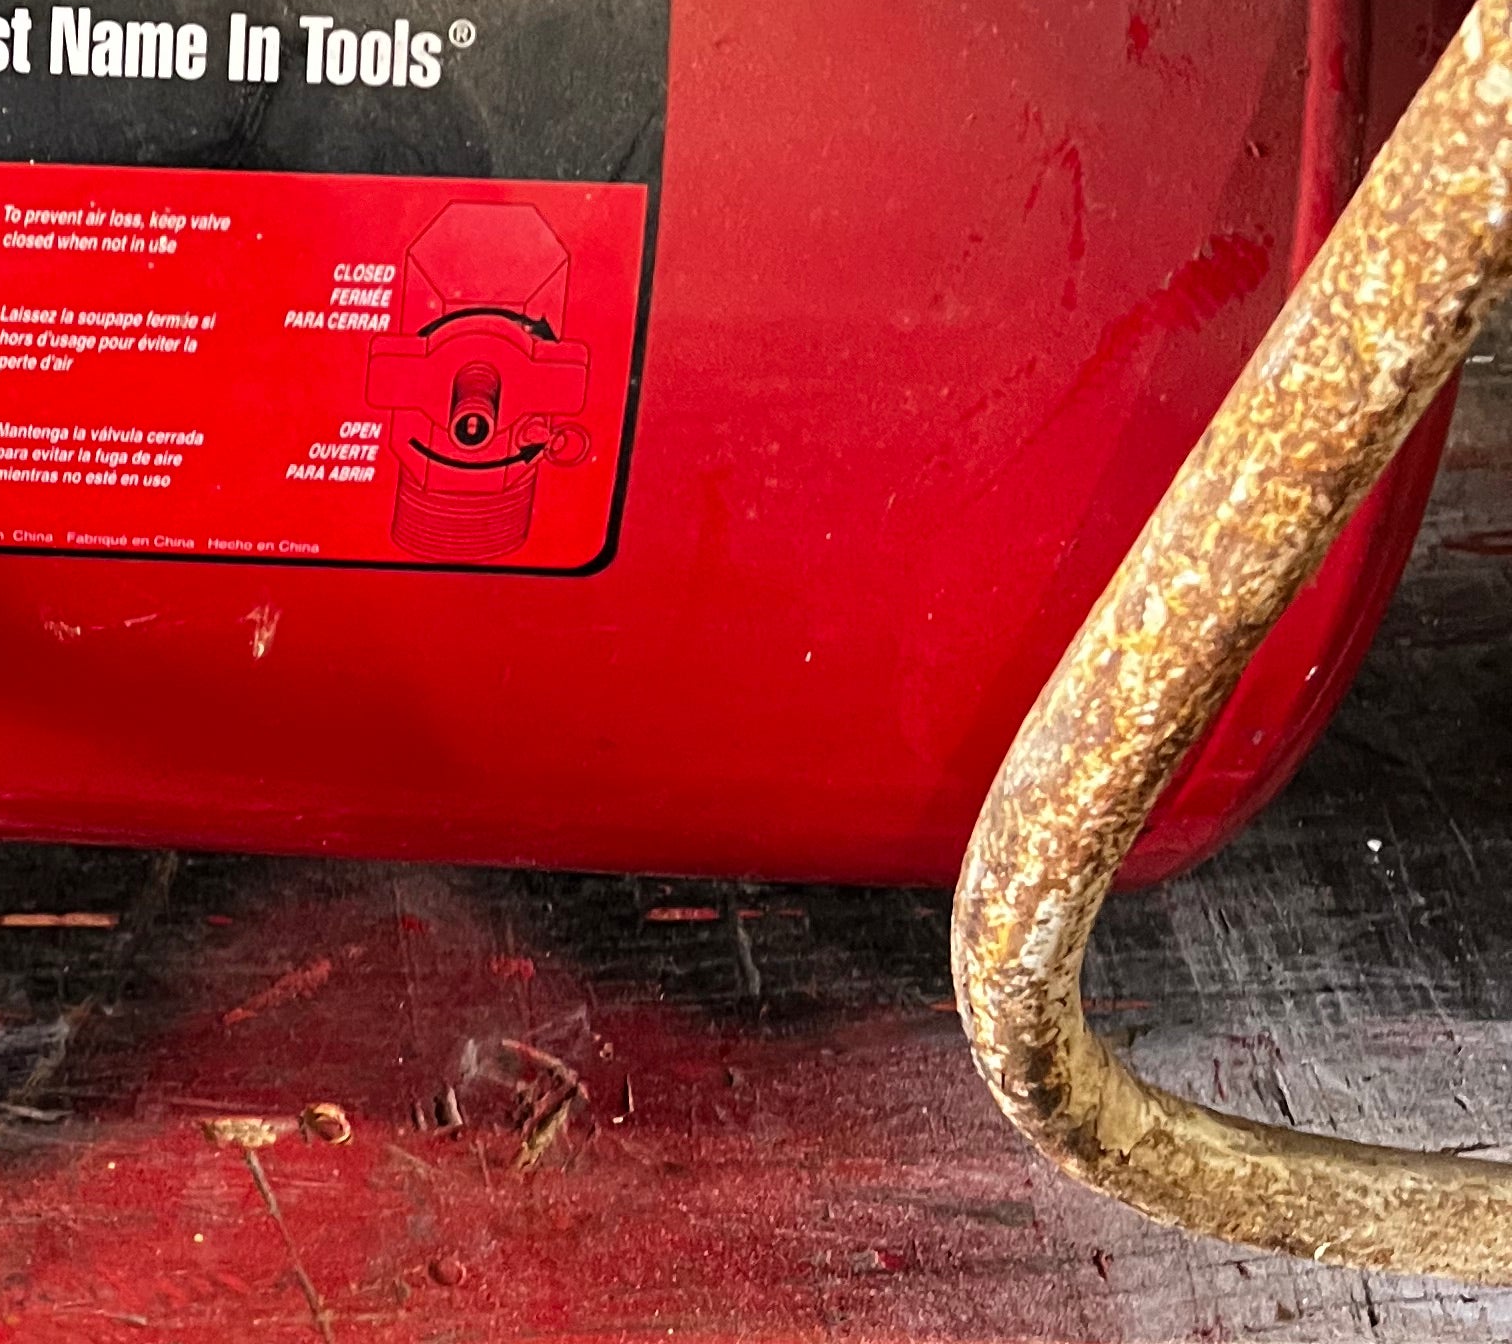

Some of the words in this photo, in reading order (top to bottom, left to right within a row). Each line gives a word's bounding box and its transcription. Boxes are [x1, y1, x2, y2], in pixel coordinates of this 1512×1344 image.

[48, 5, 208, 80] Name
[228, 12, 281, 83] In
[4, 203, 22, 224] To
[24, 208, 84, 229] prevent
[85, 208, 107, 227] air
[109, 210, 145, 231] loss,
[149, 211, 187, 233] keep
[190, 213, 231, 232] valve
[2, 231, 56, 249] closed
[57, 232, 98, 251] when
[101, 234, 128, 253] not
[130, 234, 145, 253] in
[148, 236, 178, 254] use
[333, 263, 396, 283] CLOSED
[329, 285, 393, 308] FERMÉE
[0, 304, 58, 325] Laissez
[60, 307, 75, 325] la
[77, 310, 143, 331] soupape
[200, 312, 217, 330] si
[284, 310, 325, 330] PARA
[326, 312, 391, 332] CERRAR
[0, 328, 34, 347] hors
[36, 329, 97, 353] d'usage
[97, 335, 136, 353] pour
[137, 334, 181, 353] éviter
[183, 335, 199, 354] la
[39, 354, 74, 372] d'air
[72, 425, 87, 441] la
[90, 425, 143, 444] válvula
[146, 429, 205, 446] cerrada
[338, 422, 383, 439] OPEN
[31, 445, 75, 463] evitar
[77, 447, 91, 464] la
[95, 448, 128, 468] fuga
[131, 449, 151, 466] de
[153, 449, 183, 467] aire
[308, 442, 380, 462] OUVERTE
[62, 469, 82, 485] no
[85, 469, 118, 486] esté
[120, 471, 139, 486] en
[142, 472, 171, 488] uso
[285, 464, 325, 482] PARA
[328, 465, 376, 483] ABRIR
[12, 529, 54, 543] China
[131, 536, 150, 547] en
[153, 535, 195, 549] China
[207, 538, 253, 552] Hecho
[256, 541, 275, 552] en
[278, 540, 320, 554] China
